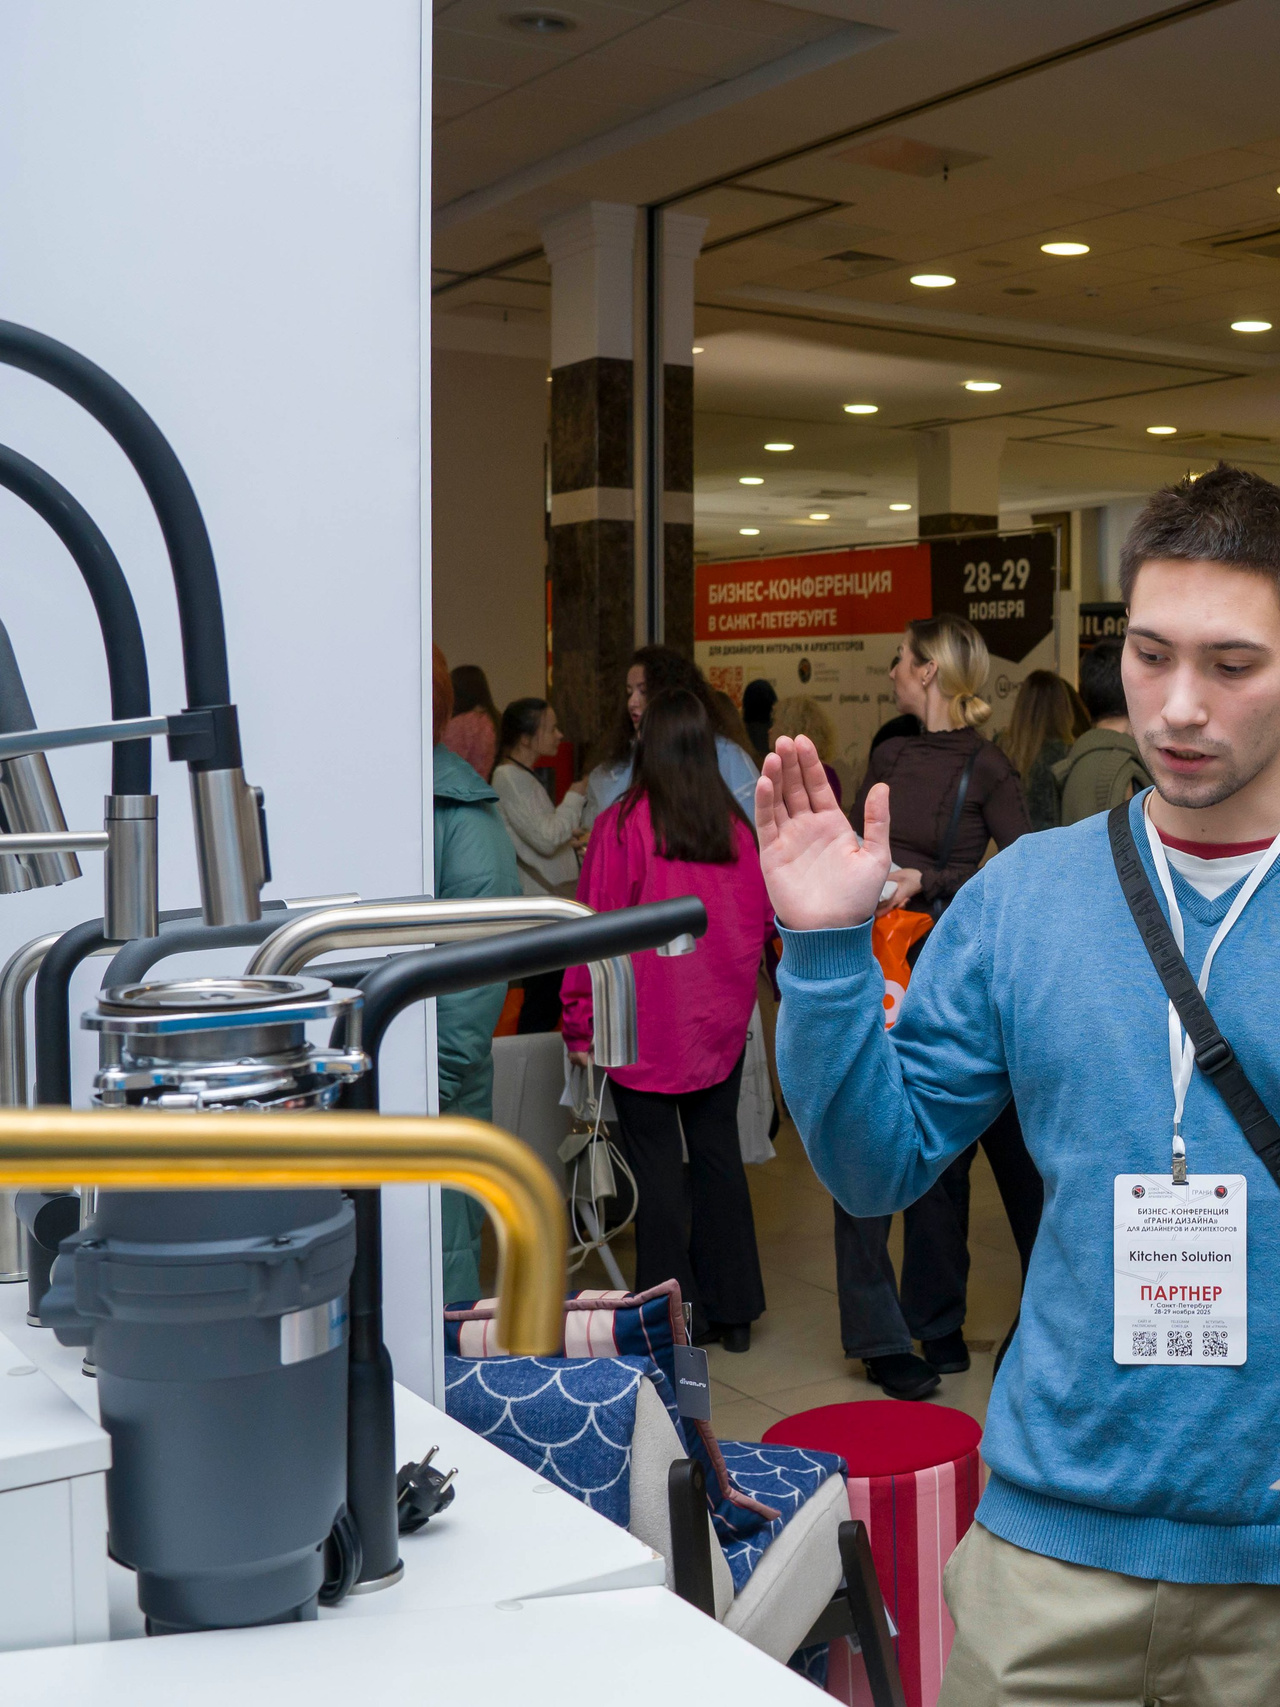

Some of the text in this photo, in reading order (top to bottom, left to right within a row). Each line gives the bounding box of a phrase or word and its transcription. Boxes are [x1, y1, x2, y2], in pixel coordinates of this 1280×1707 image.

[963, 558, 1031, 594] 28-29
[708, 570, 892, 604] БИЗНЕС-КОНФЕРЕНЦИЯ
[969, 600, 1025, 621] НОЯБРЯ
[708, 608, 837, 632] В САНКТ-ПЕТЕРБУРГЕ
[1137, 1208, 1229, 1216] БИЗНЕС-КОНФЕРЕНЦИЯ
[1175, 1216, 1218, 1225] ДИЗАЙНА»
[1129, 1251, 1232, 1262] Kitchen Solution
[1140, 1285, 1223, 1301] ПАРТНЕР
[680, 1378, 706, 1388] divan.ru
